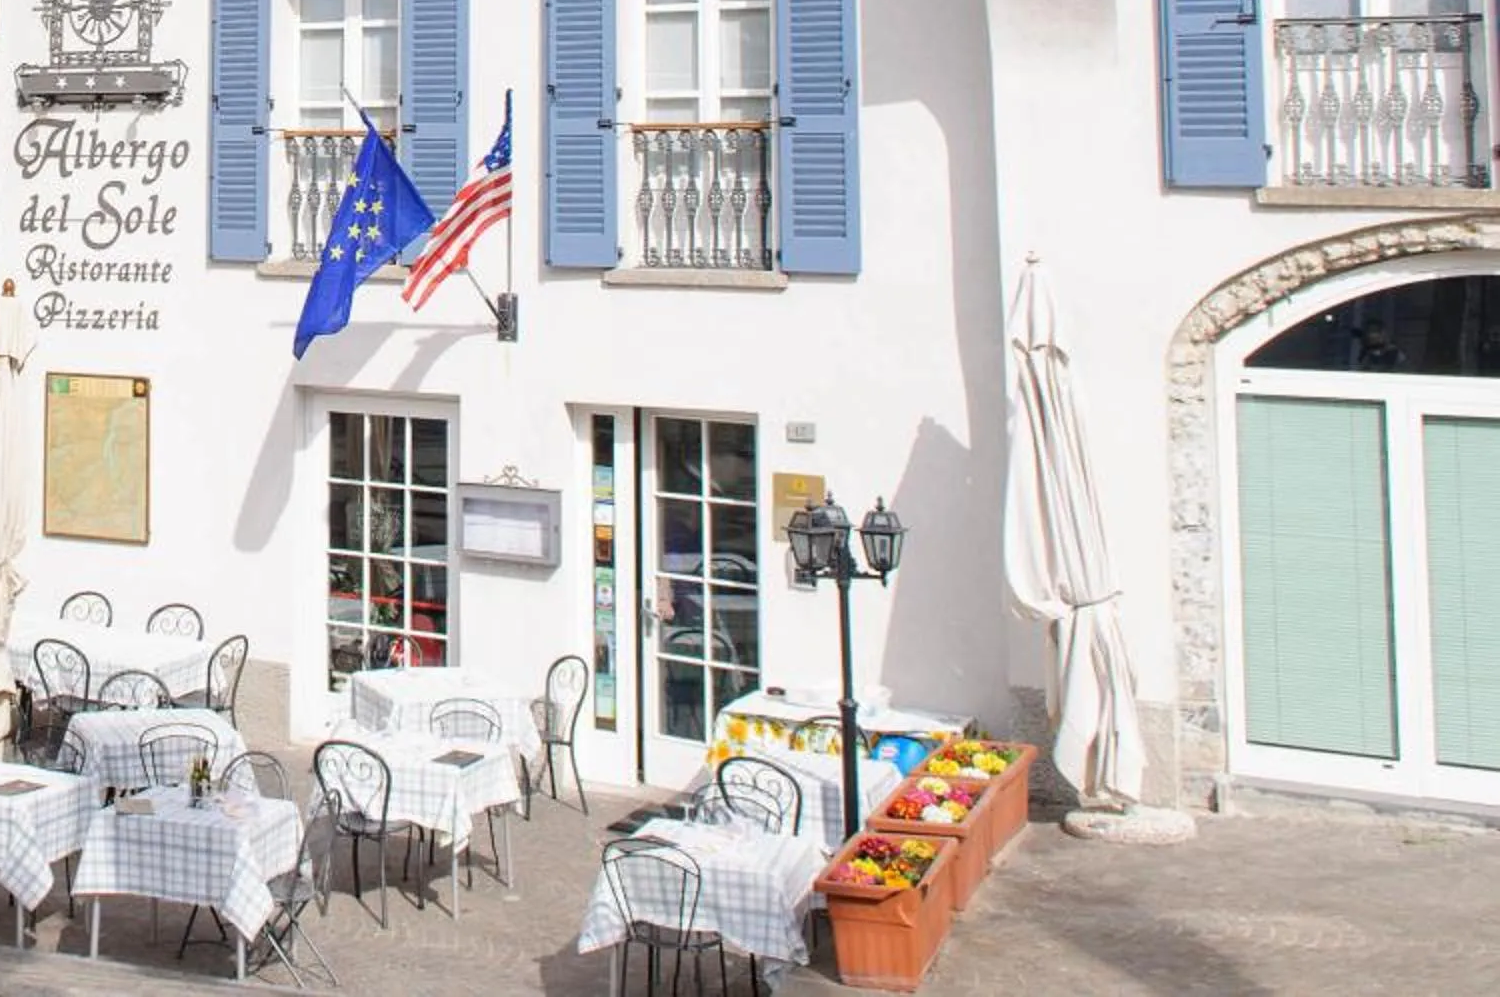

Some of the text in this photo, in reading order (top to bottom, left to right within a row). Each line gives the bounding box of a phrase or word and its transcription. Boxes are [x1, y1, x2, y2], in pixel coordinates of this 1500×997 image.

[13, 118, 190, 186] Albergo
[19, 180, 178, 250] del Sole
[25, 243, 174, 286] Ristorante
[33, 290, 161, 331] Pizzeria
